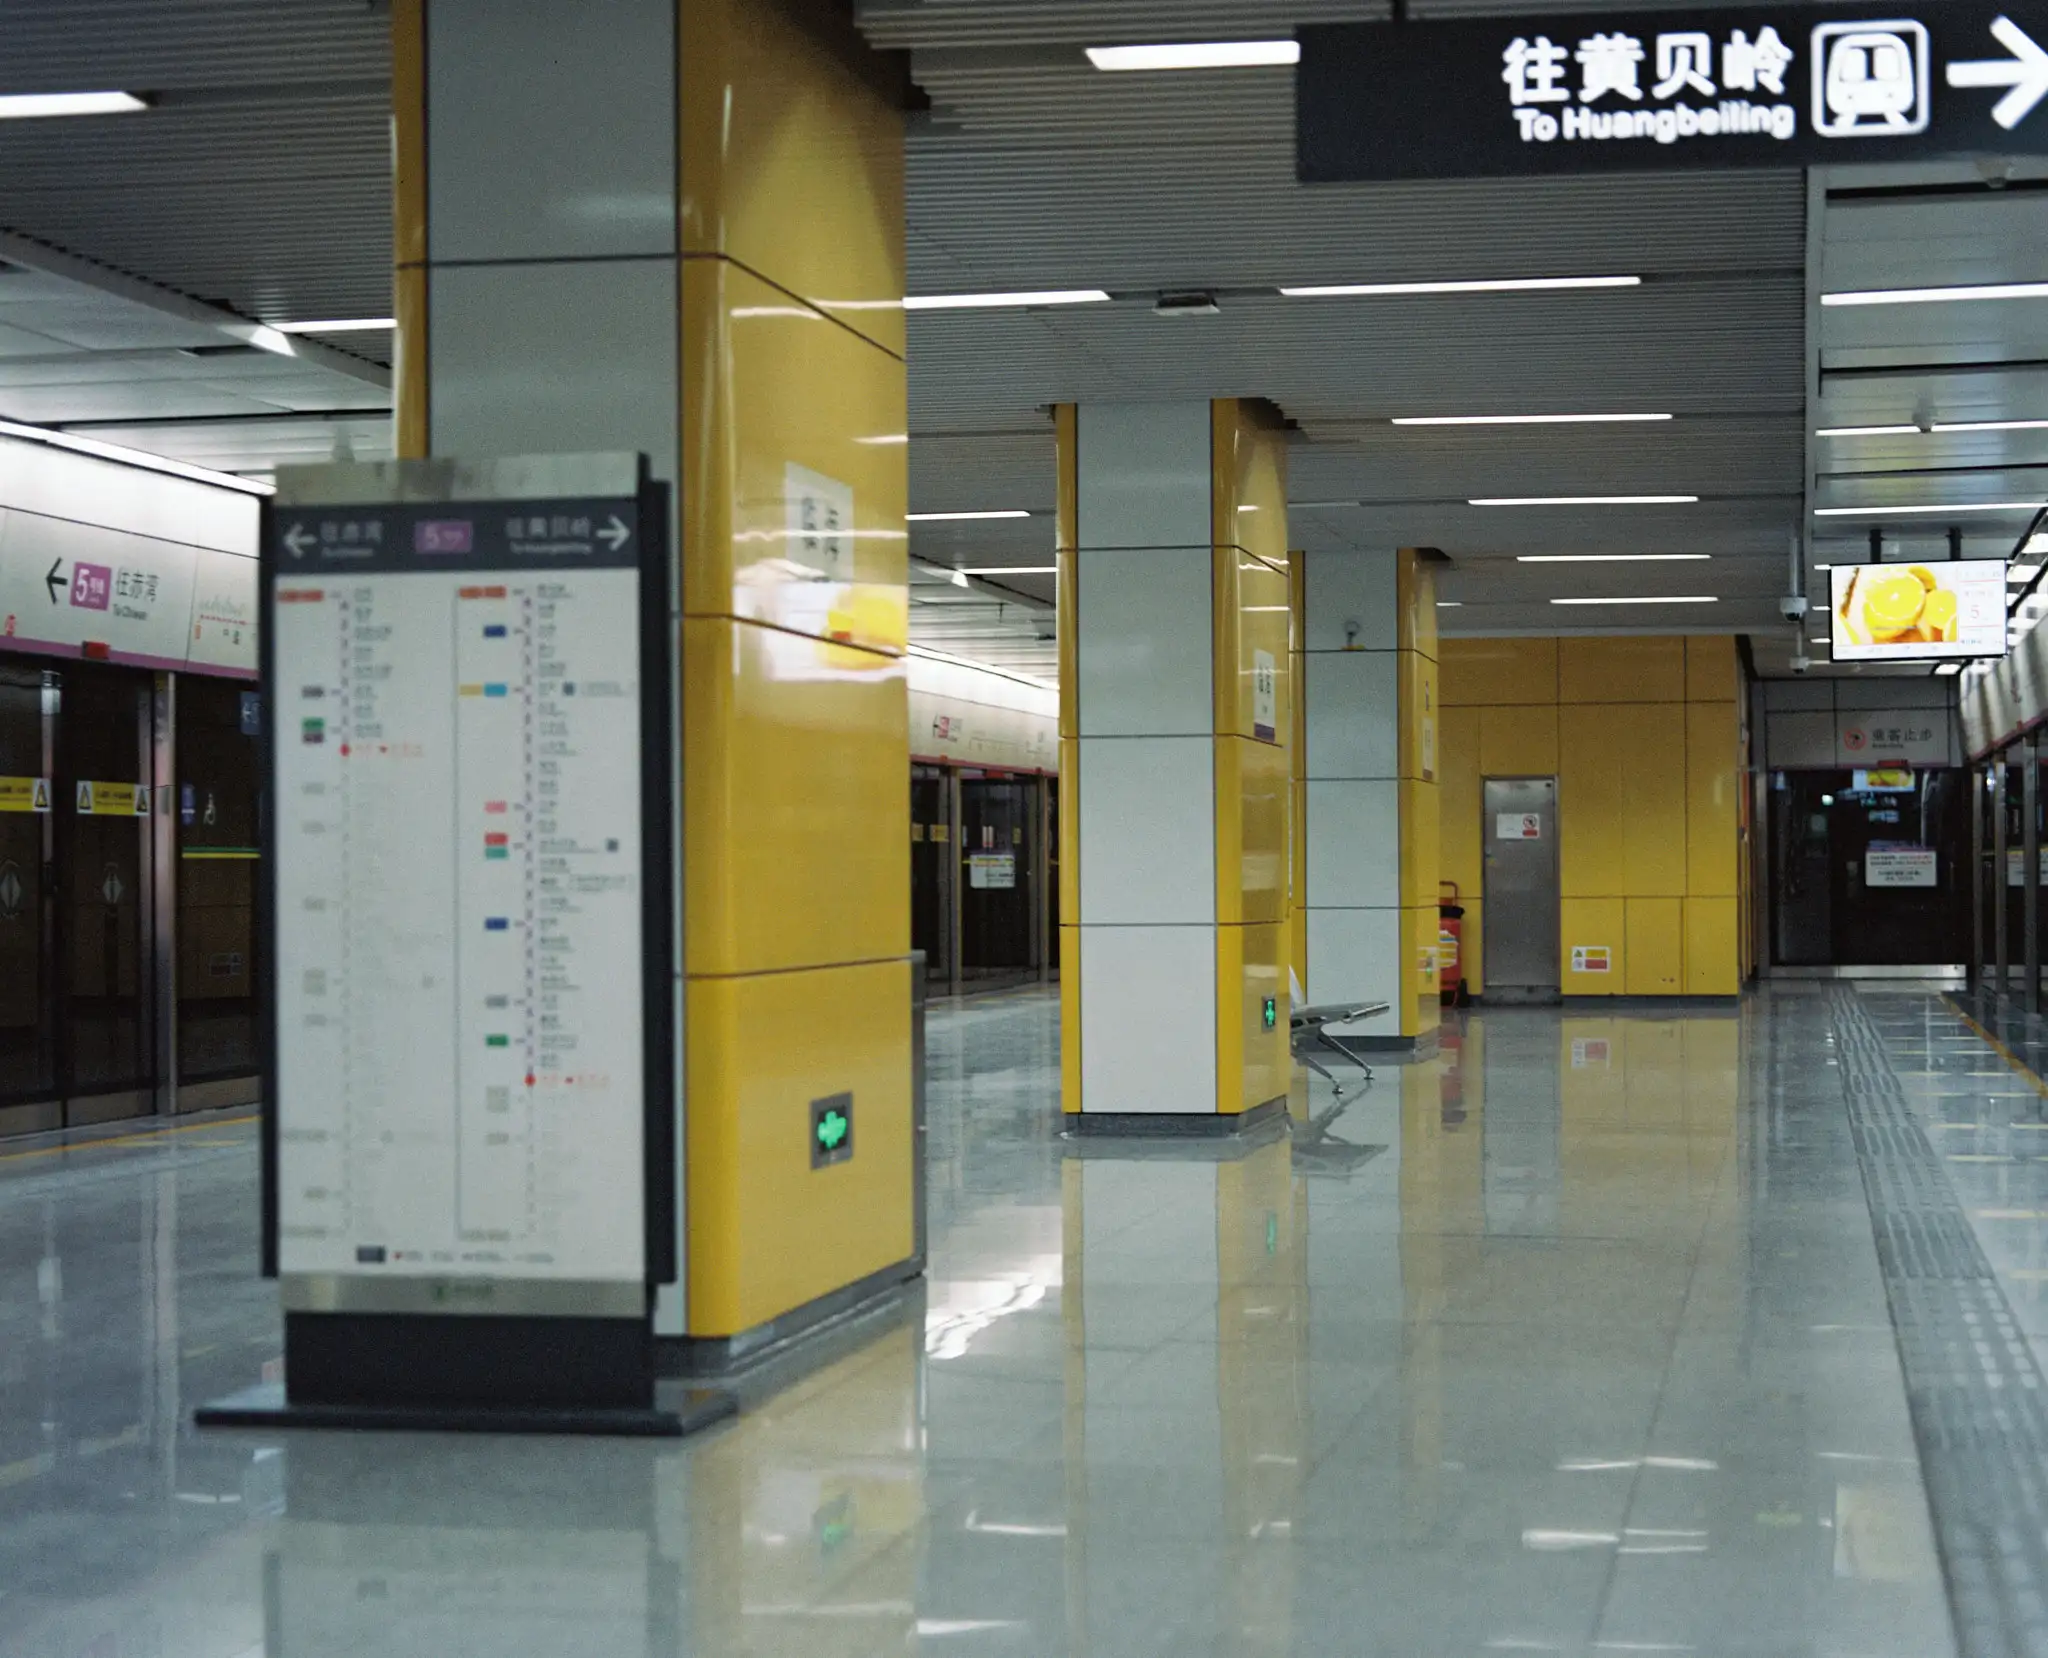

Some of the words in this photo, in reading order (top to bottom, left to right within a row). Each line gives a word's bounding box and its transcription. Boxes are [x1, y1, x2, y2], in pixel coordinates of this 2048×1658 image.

[1501, 26, 1794, 105] 往黄贝岭
[1512, 108, 1558, 141] To
[1561, 100, 1795, 143] Huangbeiling
